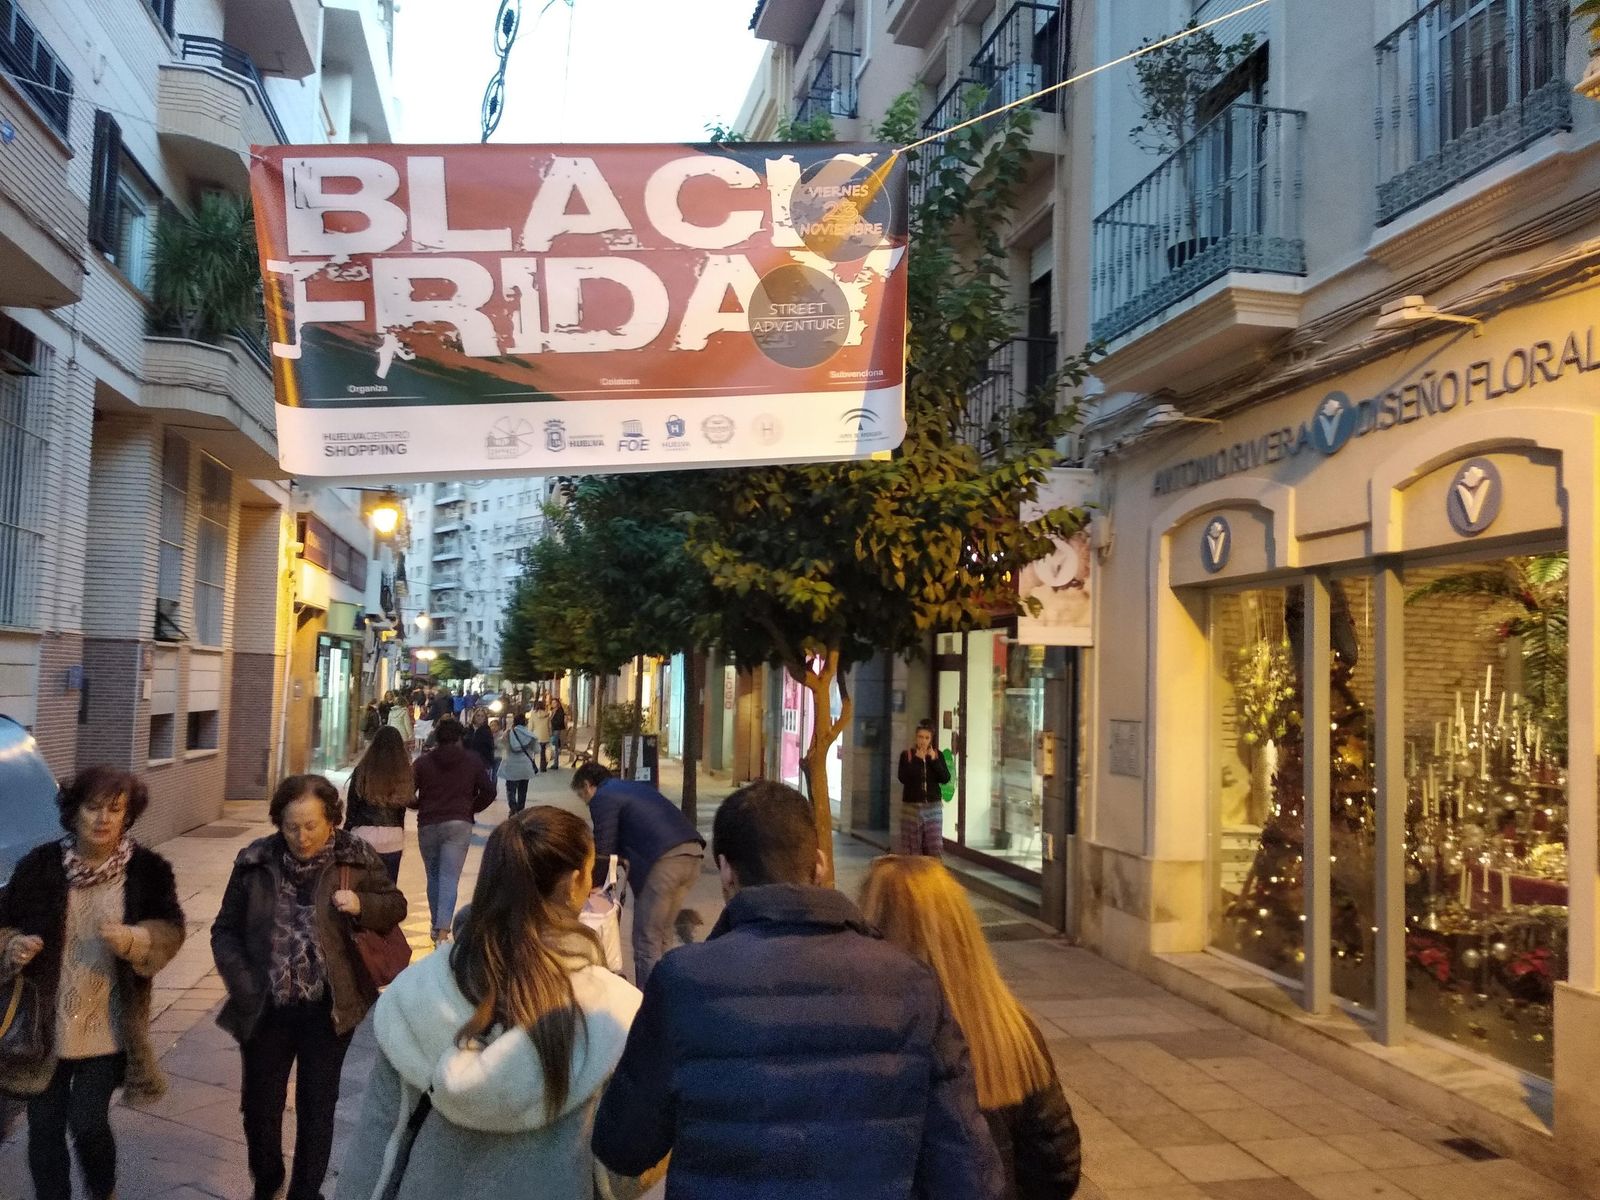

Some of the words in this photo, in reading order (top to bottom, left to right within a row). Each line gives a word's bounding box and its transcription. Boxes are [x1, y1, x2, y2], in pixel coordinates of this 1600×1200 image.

[808, 184, 868, 198] VIERNES
[281, 153, 891, 254] BLACK
[822, 200, 859, 219] 23
[801, 222, 882, 236] NOVIEMBRE
[265, 246, 906, 378] FRIDAY
[769, 302, 826, 315] STREET
[752, 317, 845, 332] ADVENTURE
[347, 384, 388, 395] Organiza
[1153, 449, 1228, 496] ANTONIO
[1229, 425, 1316, 475] RIVERA
[1354, 370, 1460, 438] DISEÑO
[1465, 326, 1600, 405] FLORAL
[324, 443, 407, 457] SHOPPING
[618, 439, 650, 452] FOE
